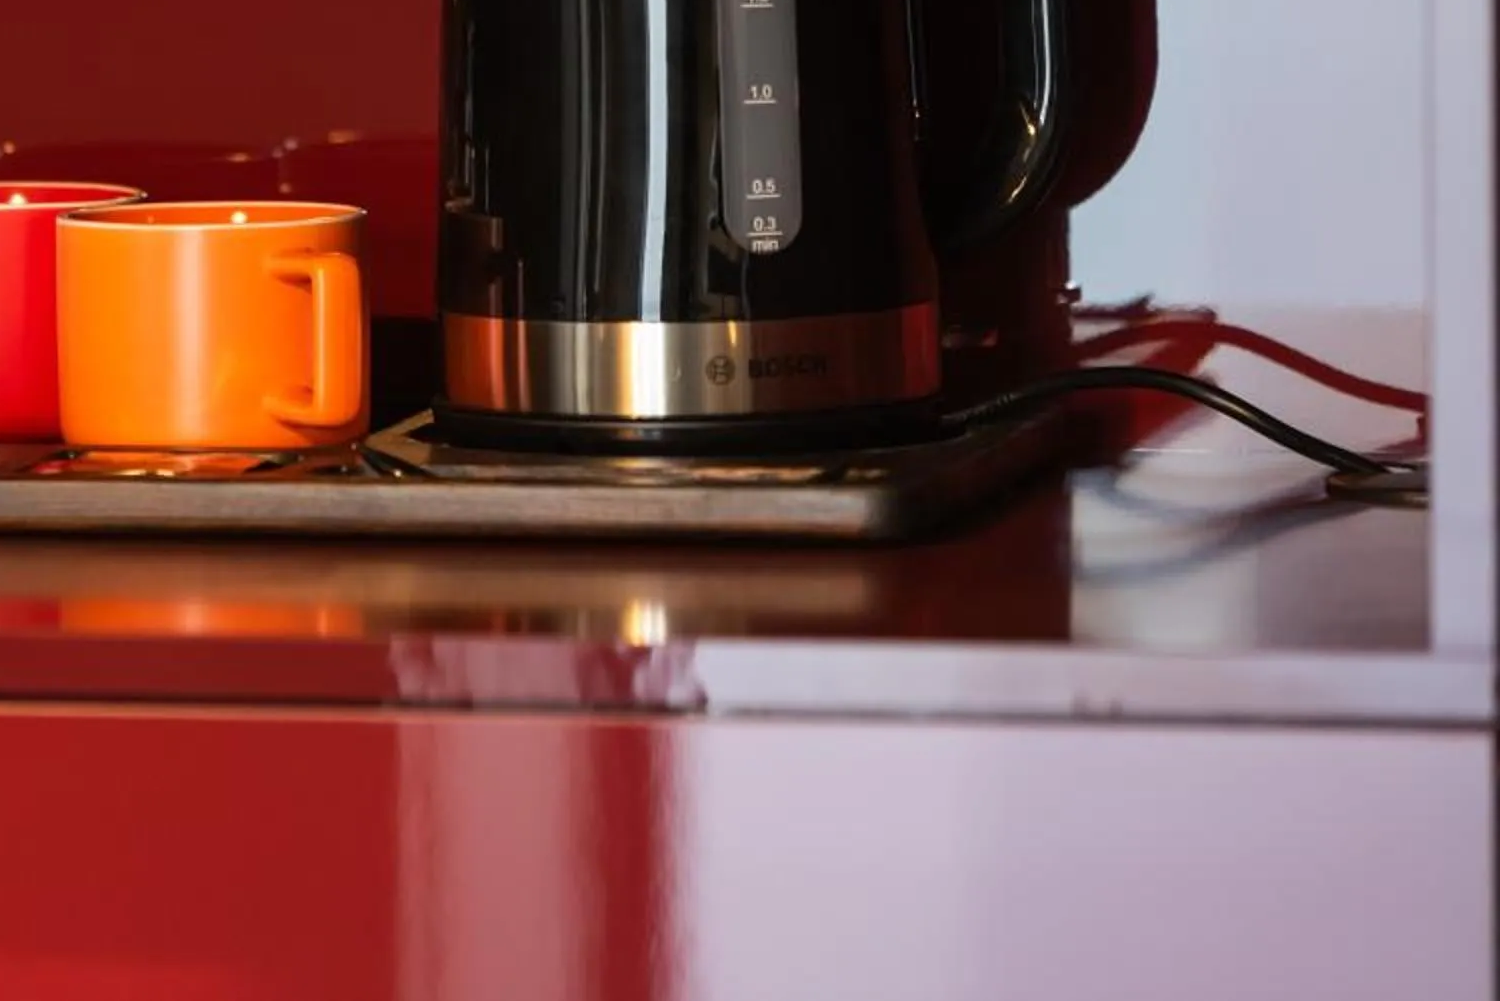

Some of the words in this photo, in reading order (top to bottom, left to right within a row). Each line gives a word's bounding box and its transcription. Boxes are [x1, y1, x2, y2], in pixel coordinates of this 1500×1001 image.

[750, 85, 772, 100] 1.0
[752, 178, 777, 194] 0.5
[753, 216, 777, 232] 0.3
[752, 238, 779, 253] min
[748, 355, 828, 378] BOSCH
